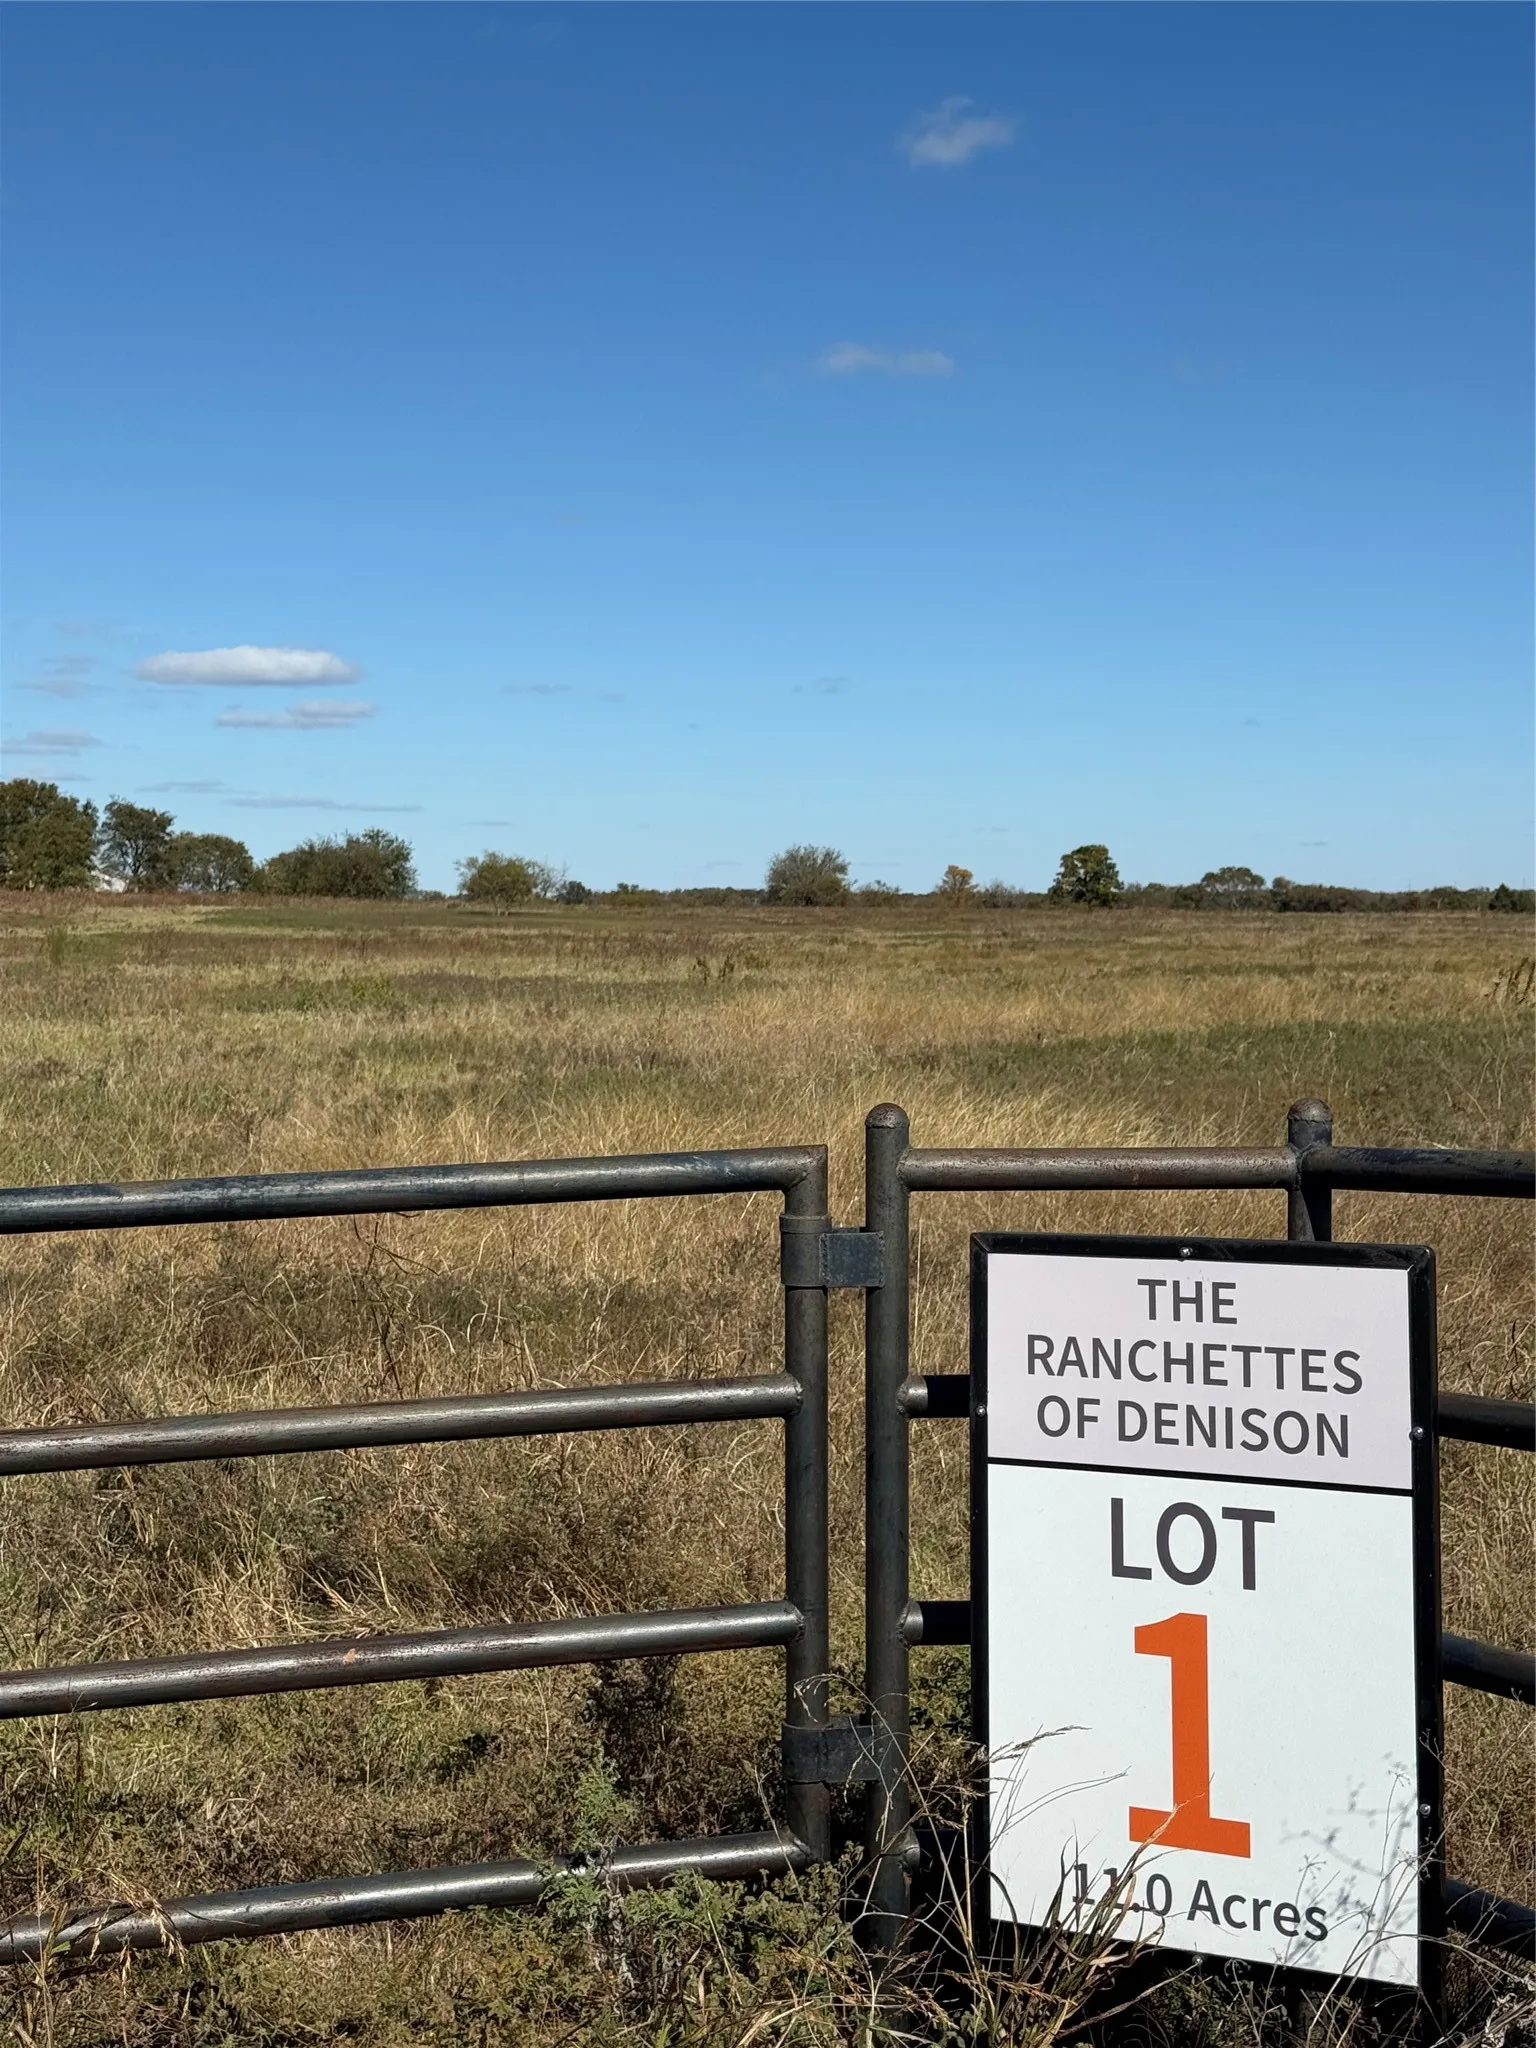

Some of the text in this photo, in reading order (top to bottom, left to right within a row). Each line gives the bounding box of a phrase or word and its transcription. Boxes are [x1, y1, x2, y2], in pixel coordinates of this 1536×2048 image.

[1137, 1278, 1237, 1325] THE
[1027, 1333, 1363, 1395] RANCHETTES
[1037, 1394, 1349, 1459] OF DENISON
[1110, 1497, 1276, 1591] LOT
[1129, 1612, 1251, 1859] 1
[1187, 1879, 1329, 1942] Acres
